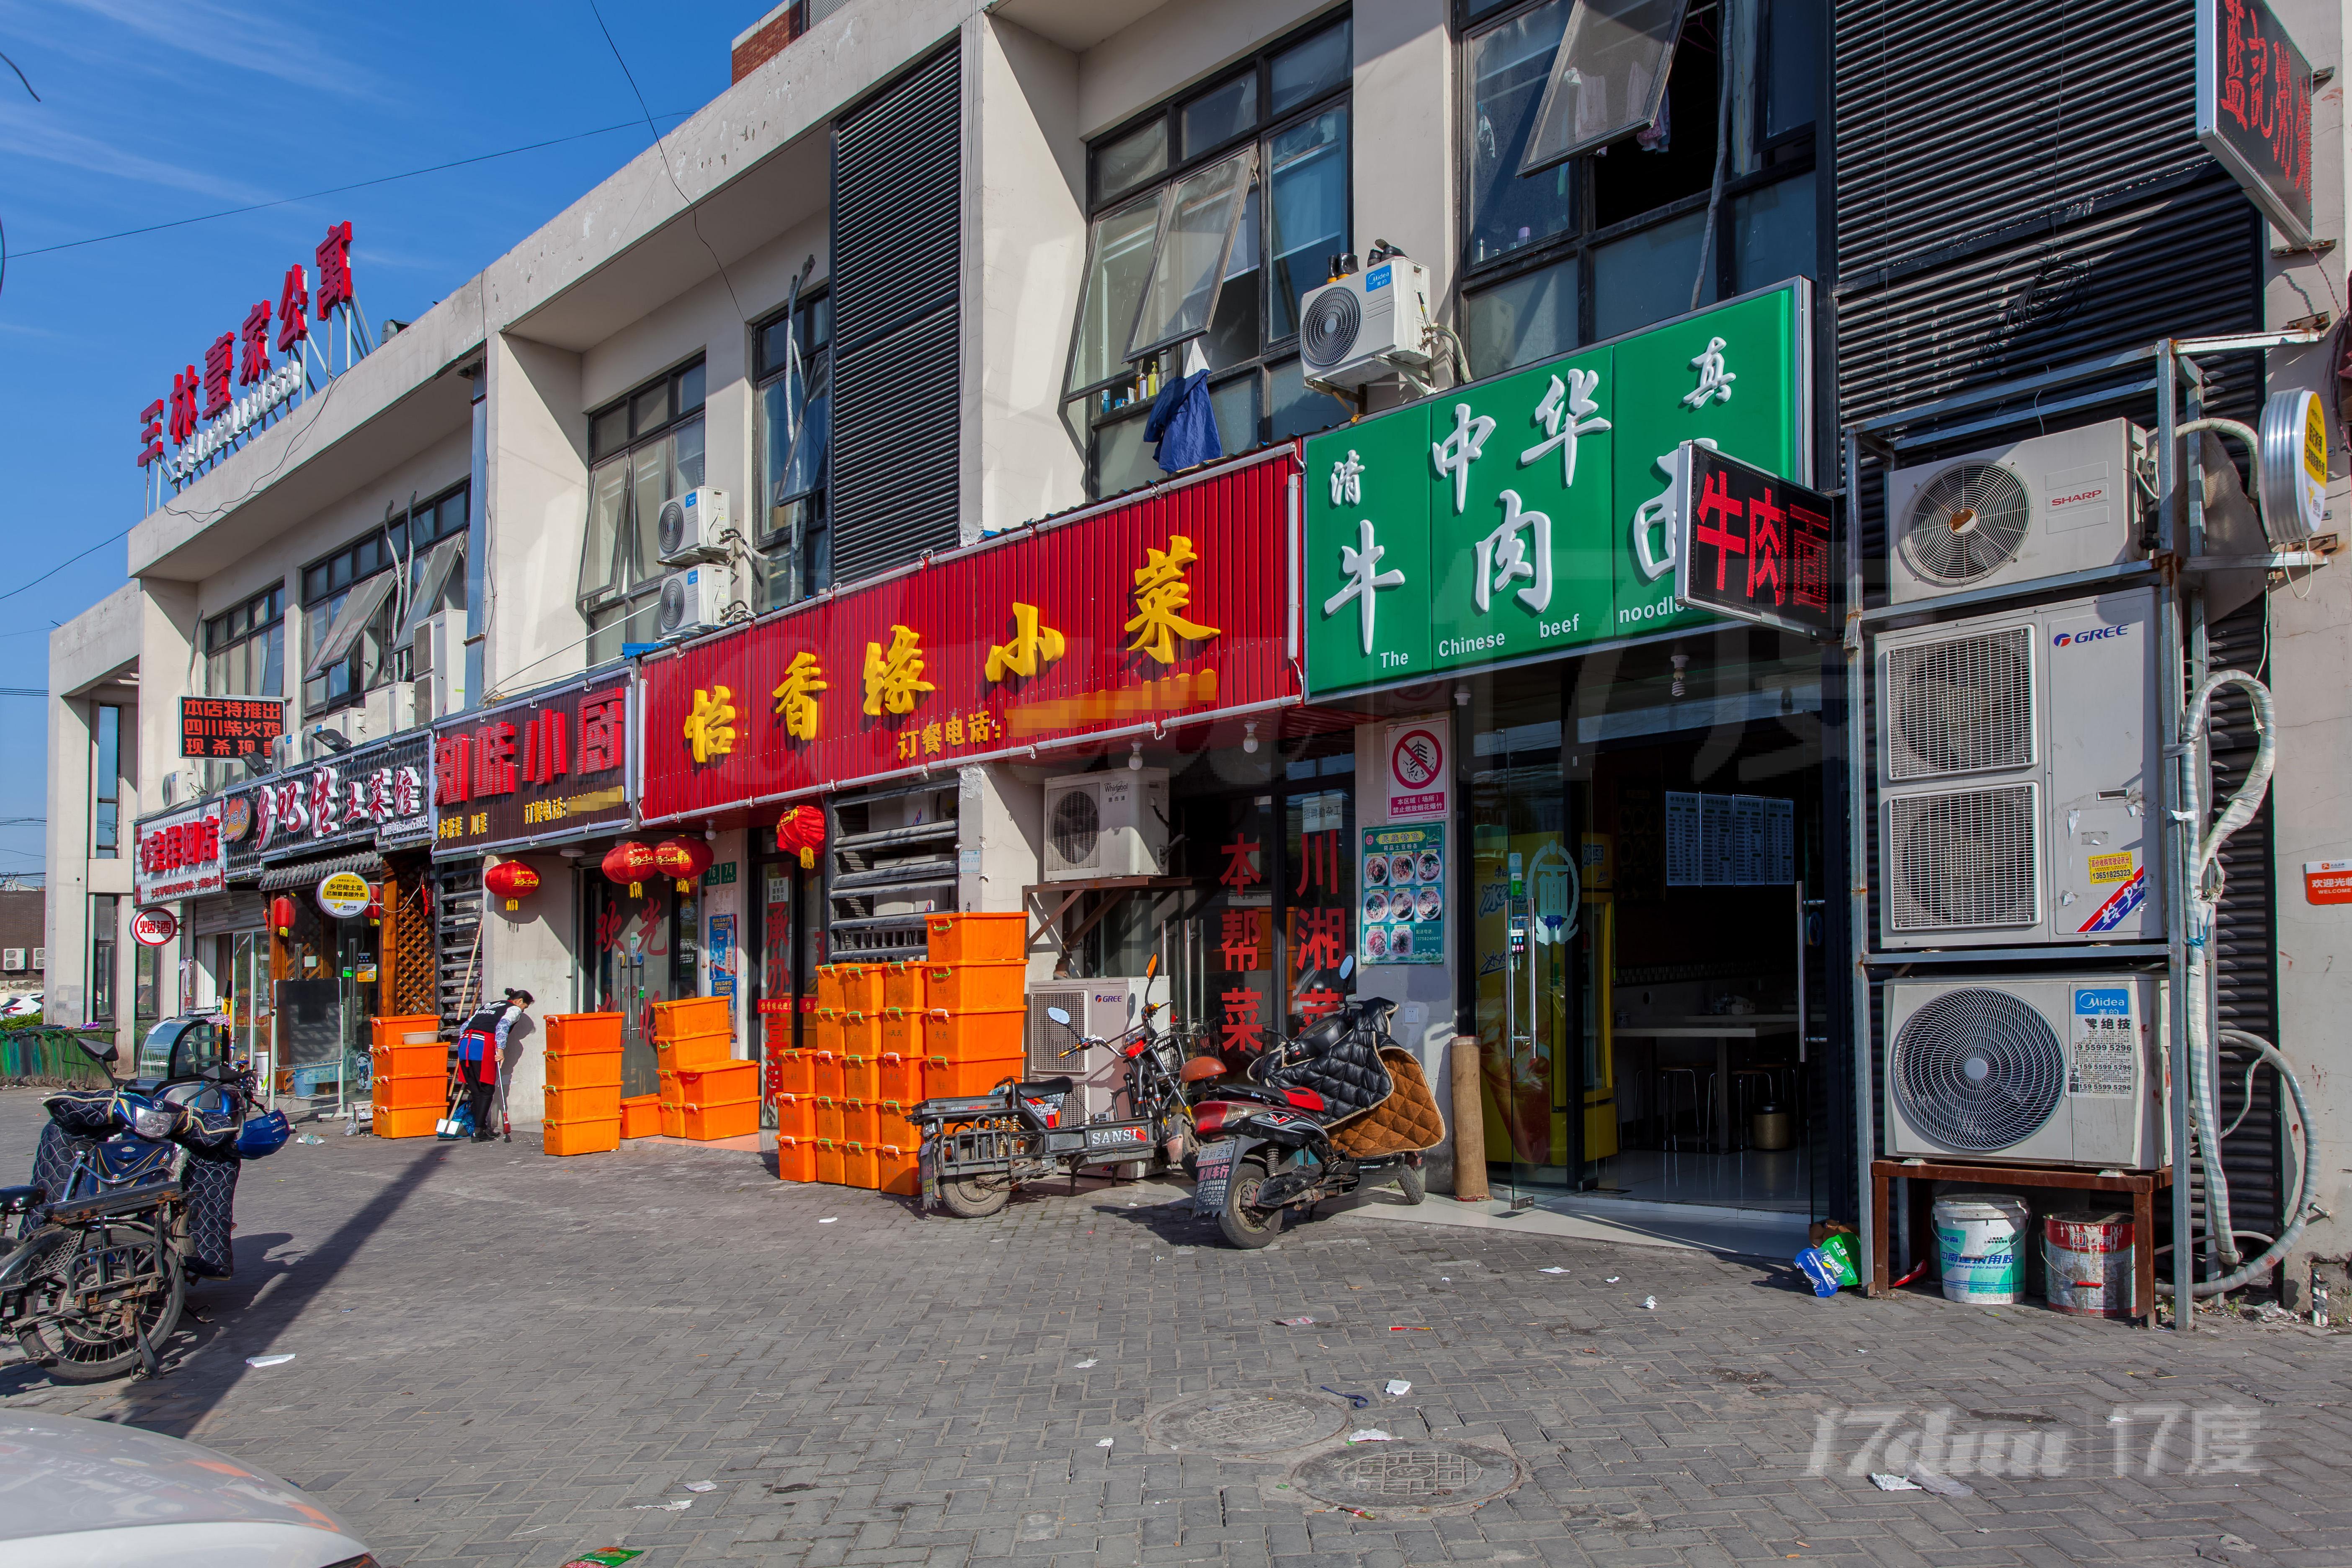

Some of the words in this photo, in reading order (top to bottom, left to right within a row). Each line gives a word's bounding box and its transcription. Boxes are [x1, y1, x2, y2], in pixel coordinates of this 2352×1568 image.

[1370, 272, 1389, 283] Midea
[1331, 450, 1364, 505] 清
[1683, 337, 1736, 408] 真
[1433, 369, 1612, 514] 中华
[2052, 489, 2102, 506] SHARP
[1697, 471, 1829, 612] 牛肉面
[1380, 651, 1408, 669] The
[1439, 633, 1505, 658] Chinese
[1540, 614, 1579, 638] beef
[2075, 624, 2129, 644] GREE
[684, 535, 1221, 763] 怡香缘小菜
[184, 700, 281, 718] 本店特推出
[184, 720, 281, 737] 四川柴火鸡
[1105, 783, 1128, 793] Whirlpool
[1393, 803, 1442, 814] 禁止燃放烟花爆竹
[438, 817, 462, 839] 本帮菜
[470, 812, 487, 835] 川菜
[1382, 833, 1421, 843] 民族特色
[709, 867, 716, 878] 76
[725, 864, 732, 876] 74
[2092, 869, 2131, 879] 13651825323
[140, 920, 171, 934] 烟酒
[1220, 833, 1262, 1052] 本帮菜
[2083, 994, 2125, 1008] Midea
[1092, 1129, 1138, 1144] SANSI
[1200, 1146, 1233, 1160] 豪爵之星
